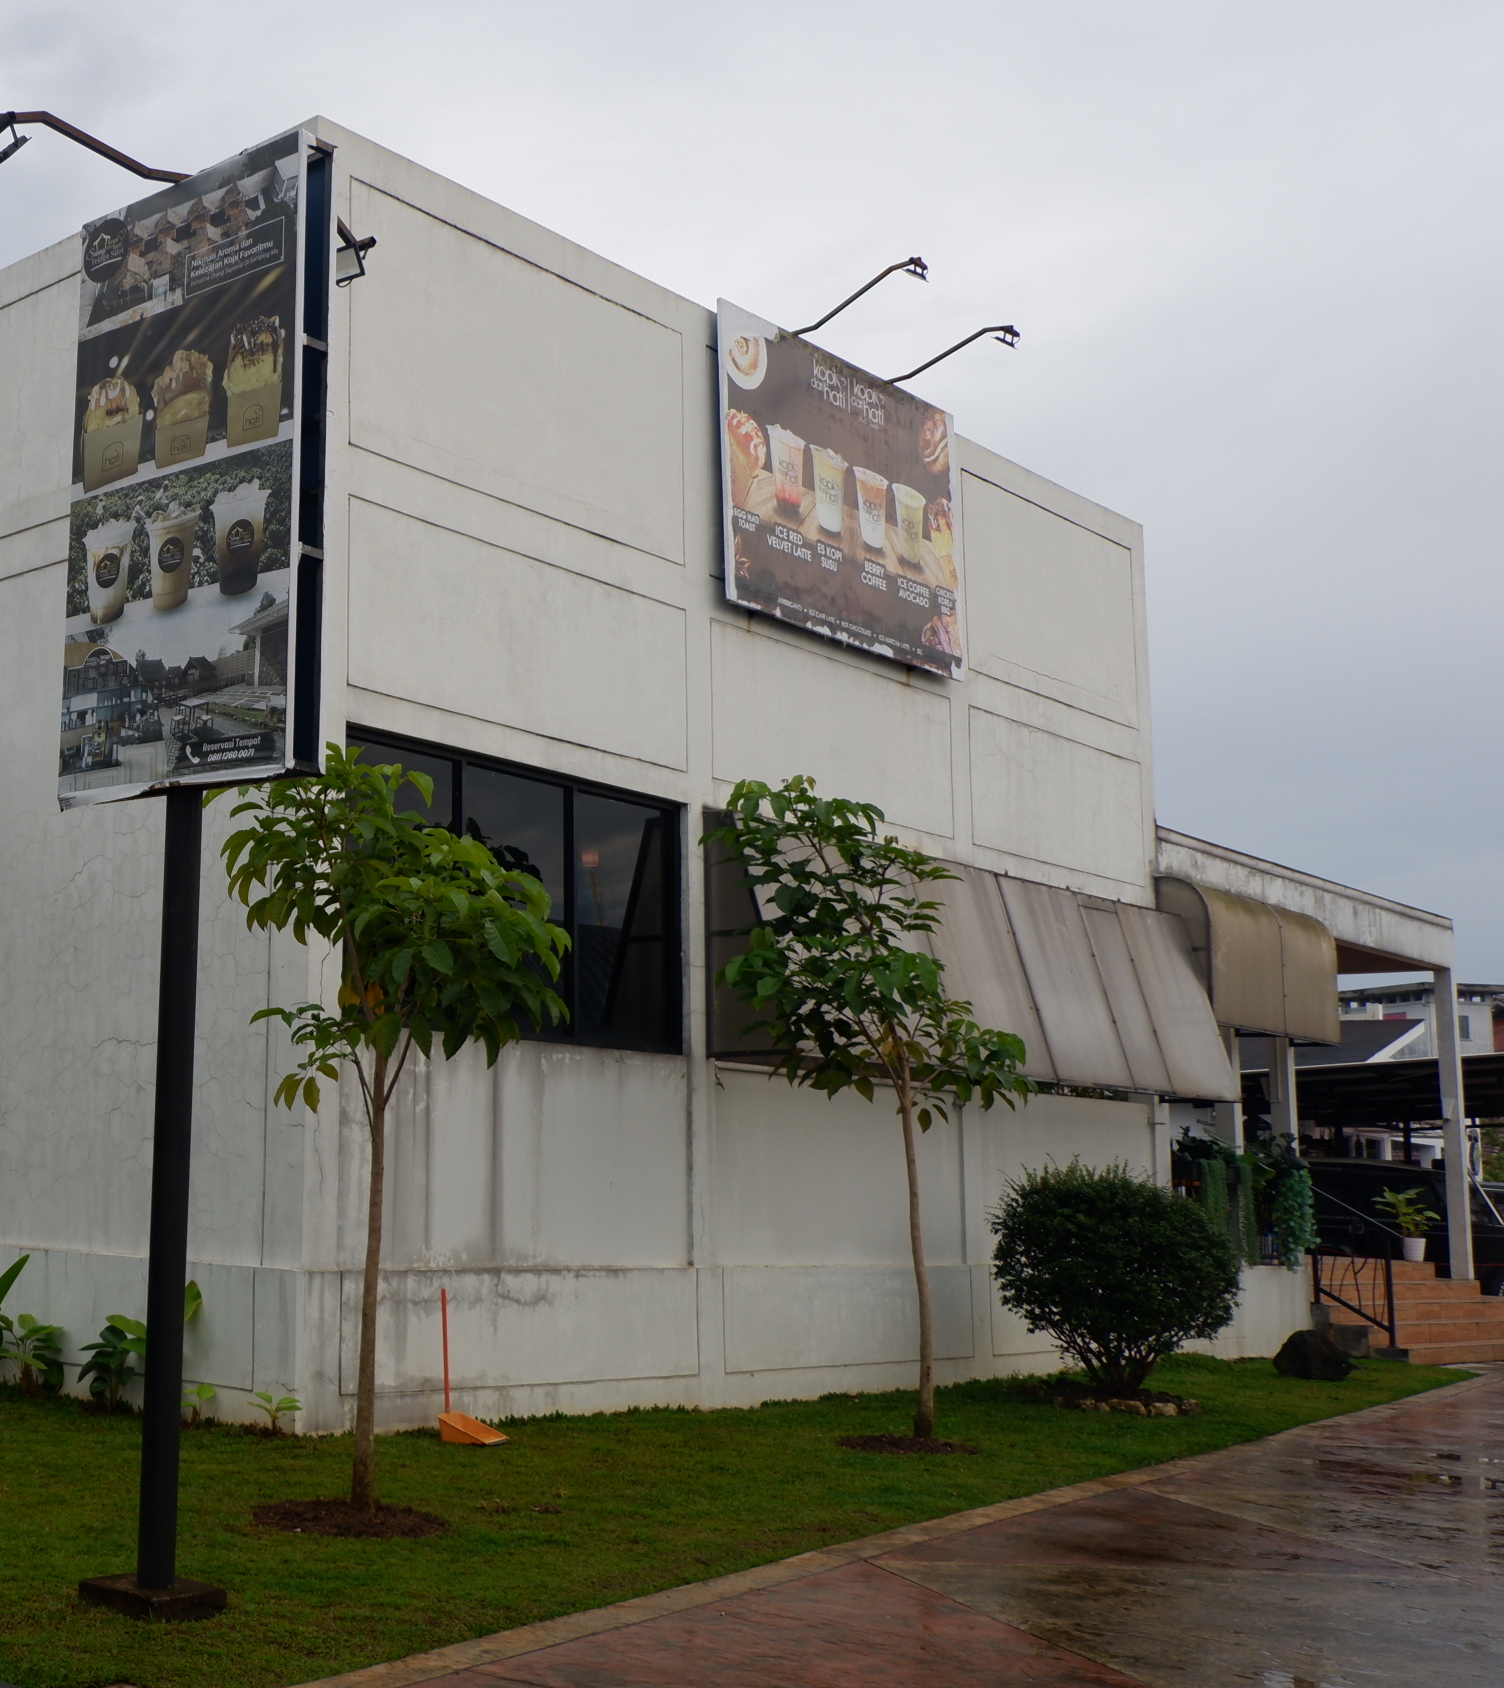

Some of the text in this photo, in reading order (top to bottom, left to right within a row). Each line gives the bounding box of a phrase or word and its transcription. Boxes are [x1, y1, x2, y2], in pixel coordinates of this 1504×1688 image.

[190, 240, 274, 278] Kelezatan Kopi Favoritmu
[191, 238, 253, 268] Nikmati Aroma dan
[813, 358, 836, 387] kopi
[824, 383, 846, 410] hati
[853, 377, 876, 404] kopi
[863, 401, 885, 426] hati
[733, 507, 760, 525] EGG HATI
[738, 519, 756, 532] TOAST
[775, 525, 803, 545] ICE RED
[766, 533, 812, 562] VELVET LATTE
[817, 542, 843, 562] ES KOPI
[820, 556, 838, 572] SUSU
[864, 560, 885, 578] BERRY
[861, 571, 887, 591] COFFEE
[897, 577, 930, 598] ICE COFFEE
[898, 588, 929, 608] AVOCADO
[848, 623, 872, 637] CHOCOLATE
[202, 735, 261, 752] Reservasi Tempat
[207, 748, 255, 761] 0811 1260 0071
